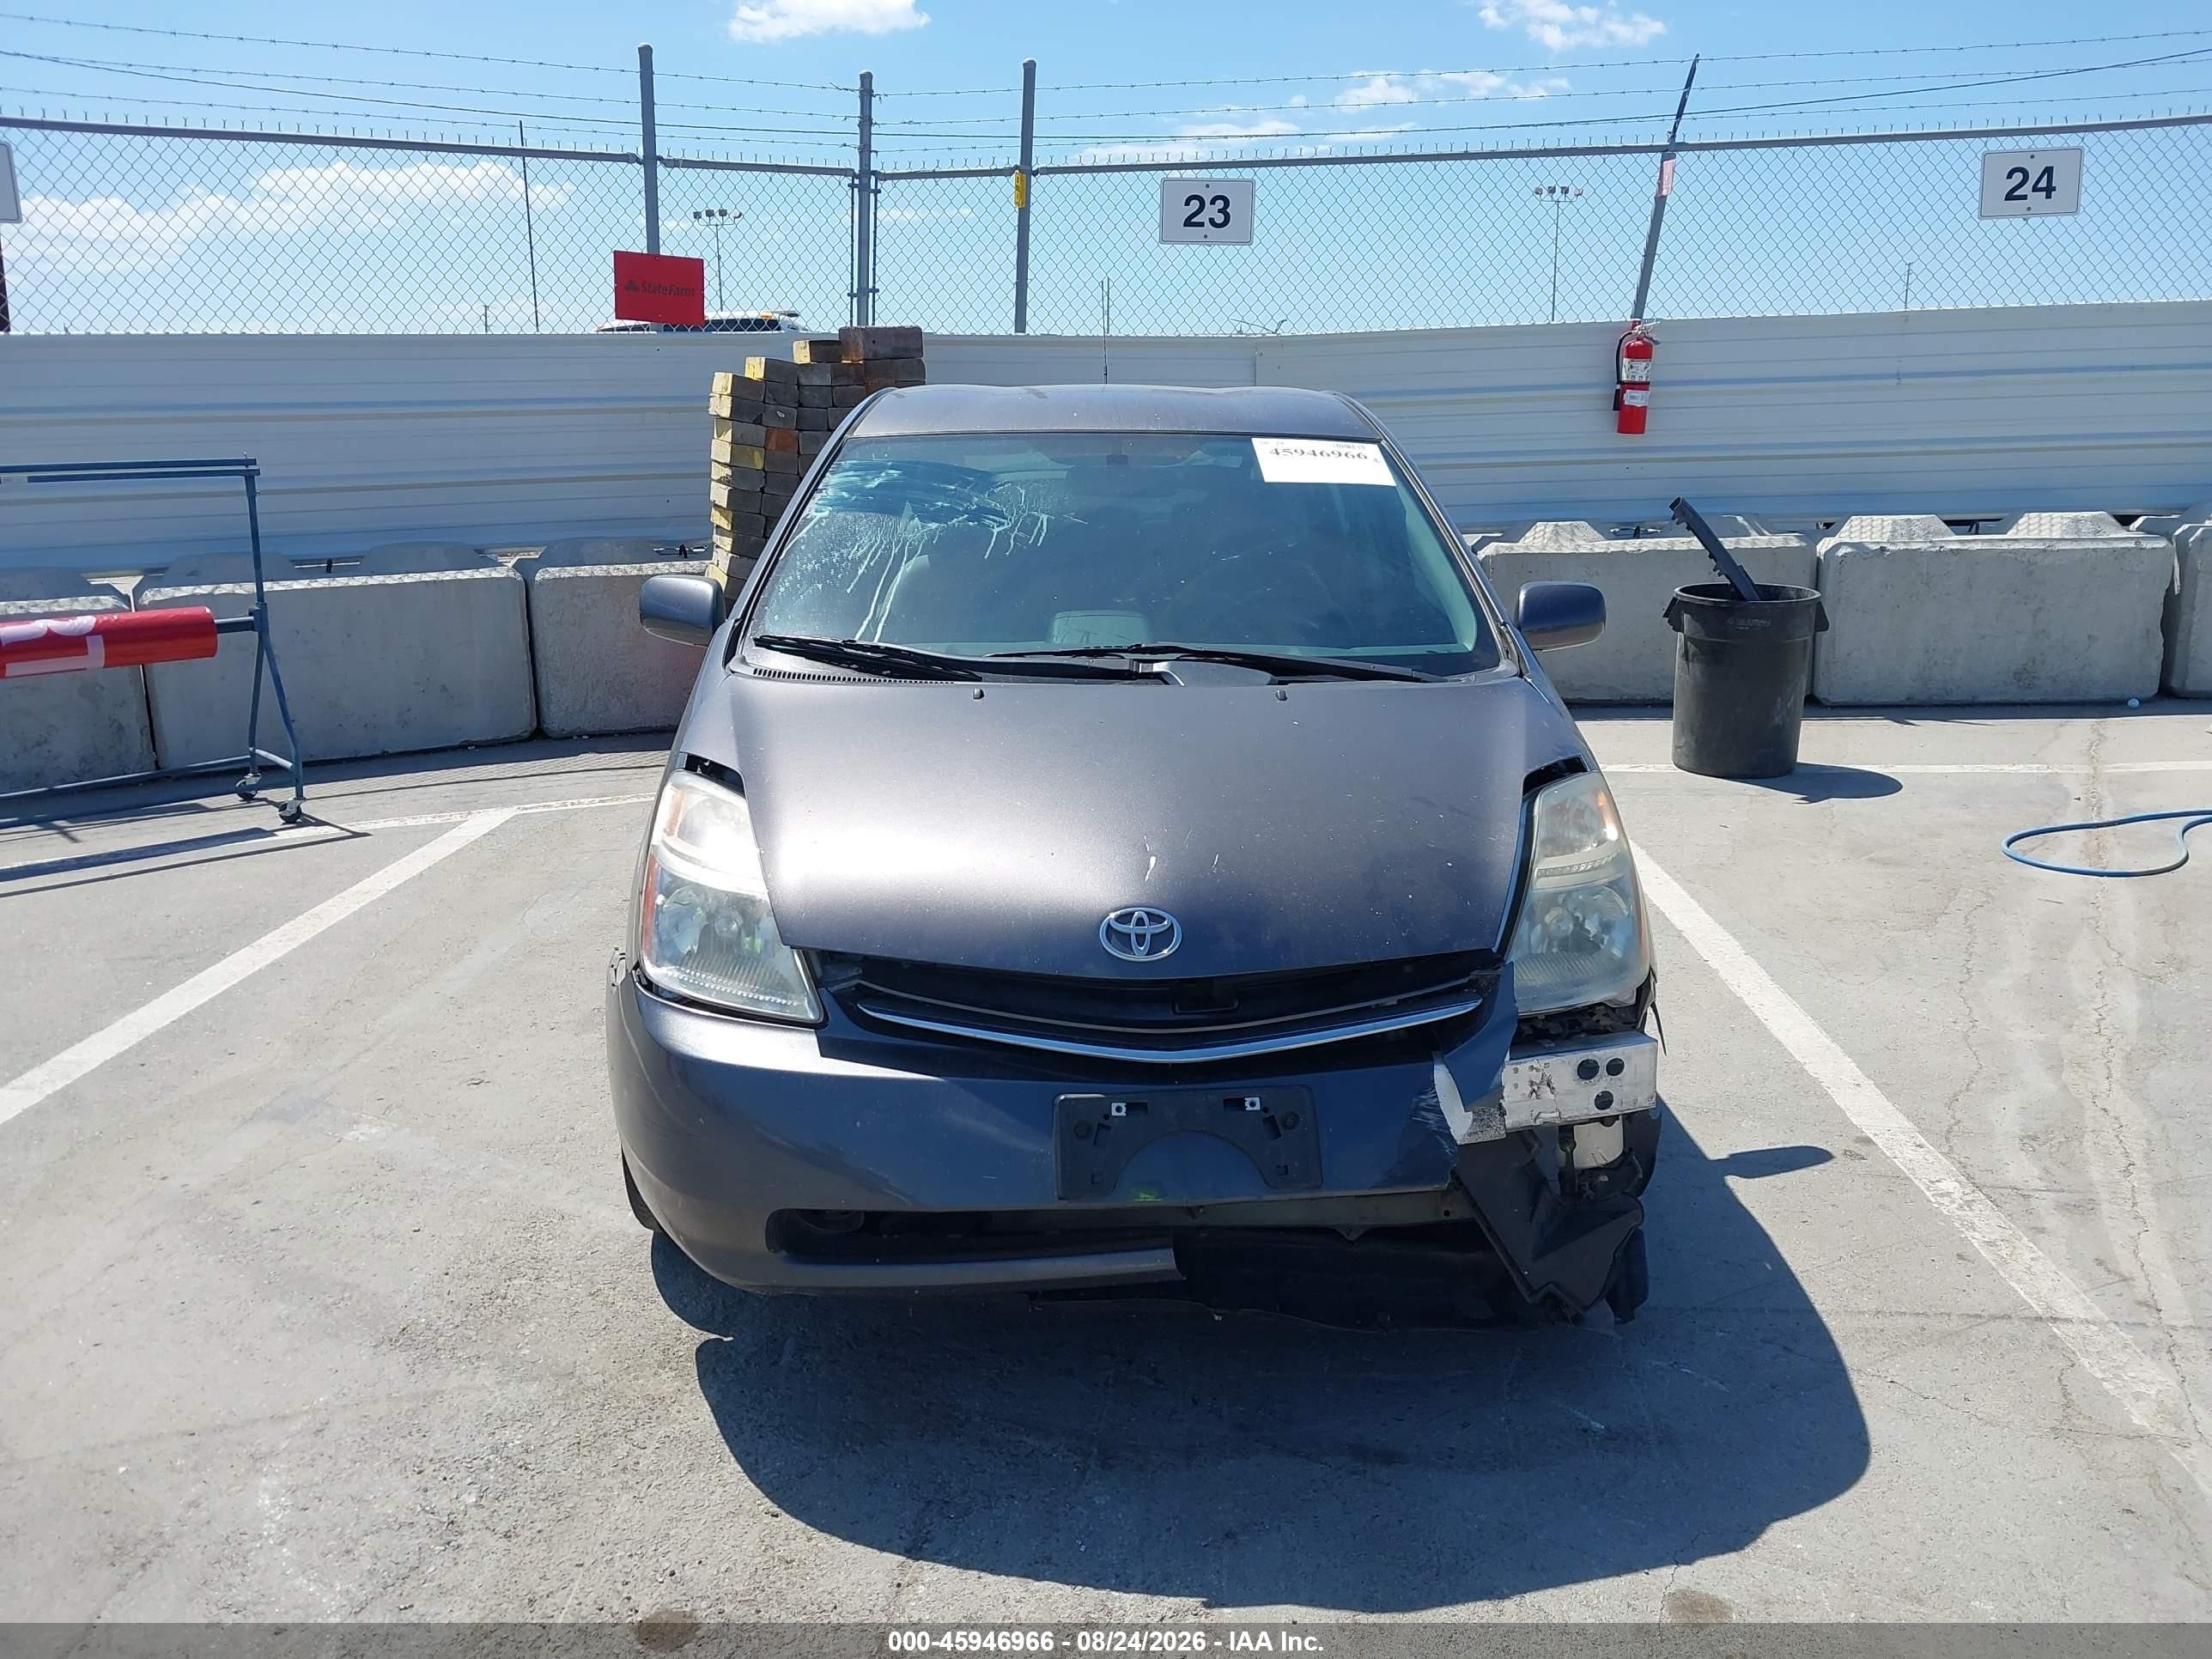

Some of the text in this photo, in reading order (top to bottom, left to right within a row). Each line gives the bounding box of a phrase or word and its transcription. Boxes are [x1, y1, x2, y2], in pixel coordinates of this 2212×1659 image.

[2004, 166, 2057, 202] 24
[1182, 194, 1231, 229] 23
[1269, 447, 1368, 460] 45946966
